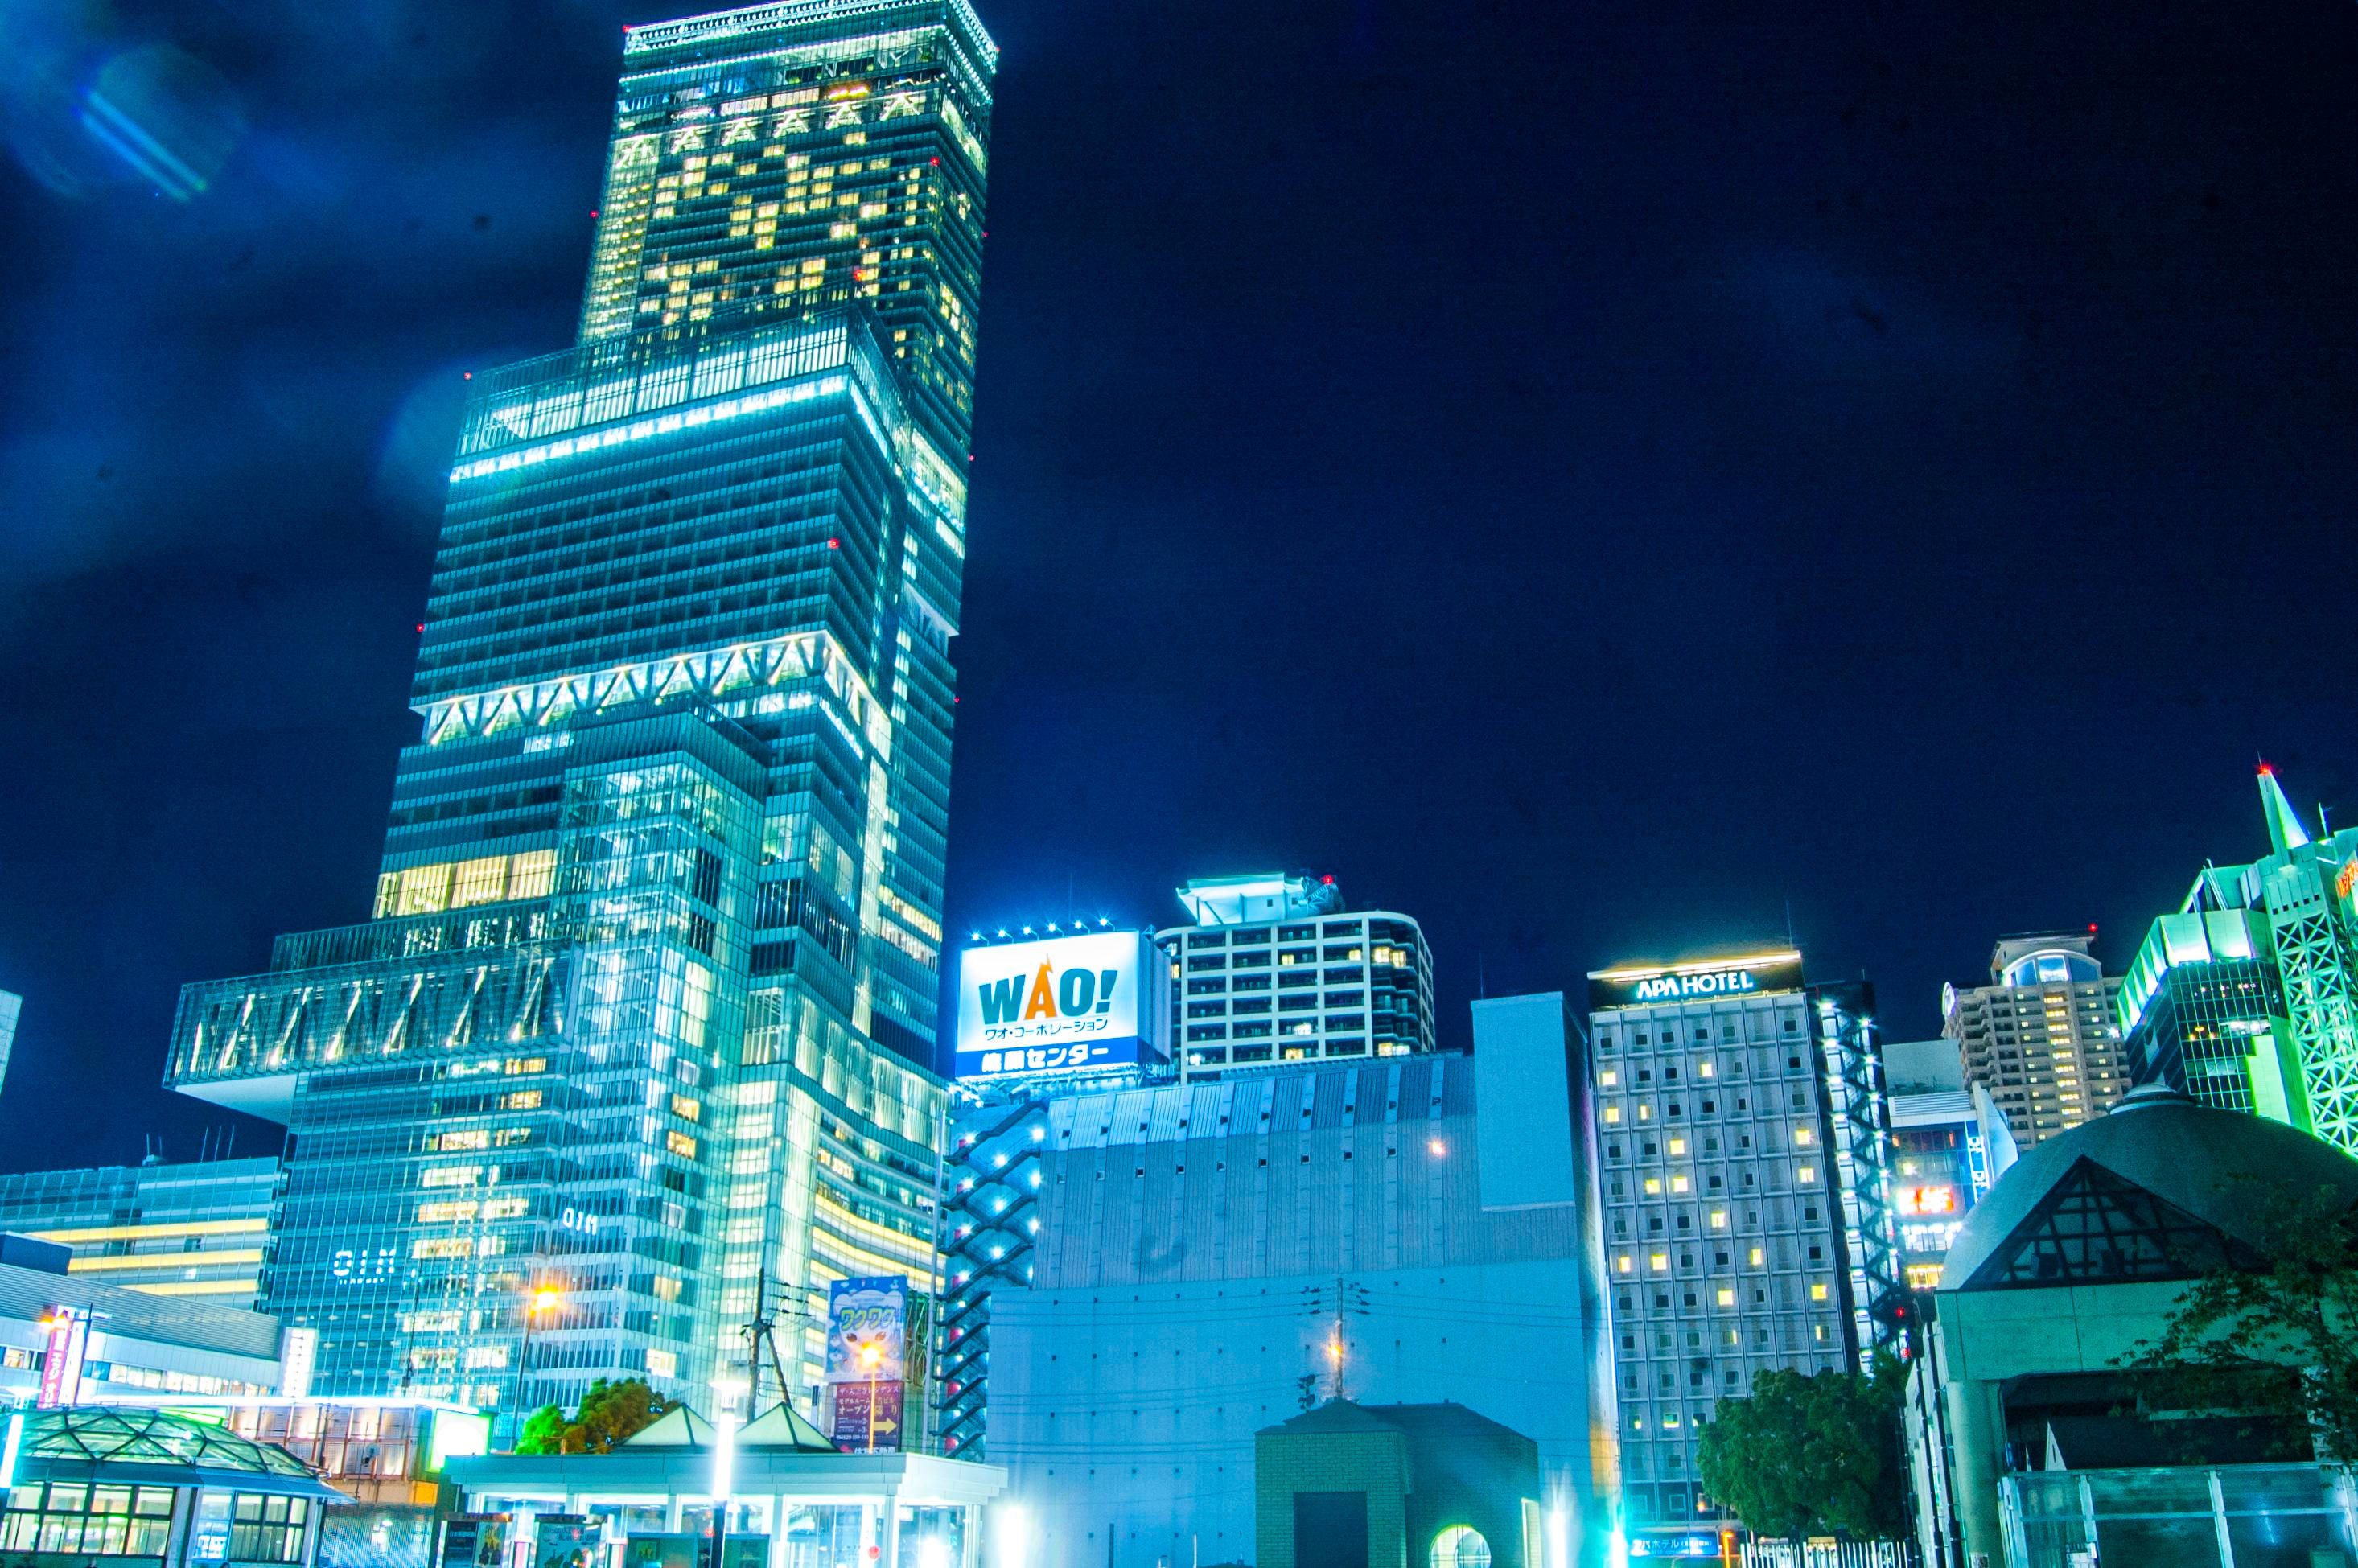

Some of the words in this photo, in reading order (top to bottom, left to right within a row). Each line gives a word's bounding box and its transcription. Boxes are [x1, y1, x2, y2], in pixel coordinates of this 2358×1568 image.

[978, 954, 1118, 1025] WAO!
[1636, 977, 1680, 999] APA
[1681, 971, 1754, 994] HOTEL
[985, 1018, 1108, 1041] ワオ・コーポレーション
[838, 1405, 870, 1415] オープン
